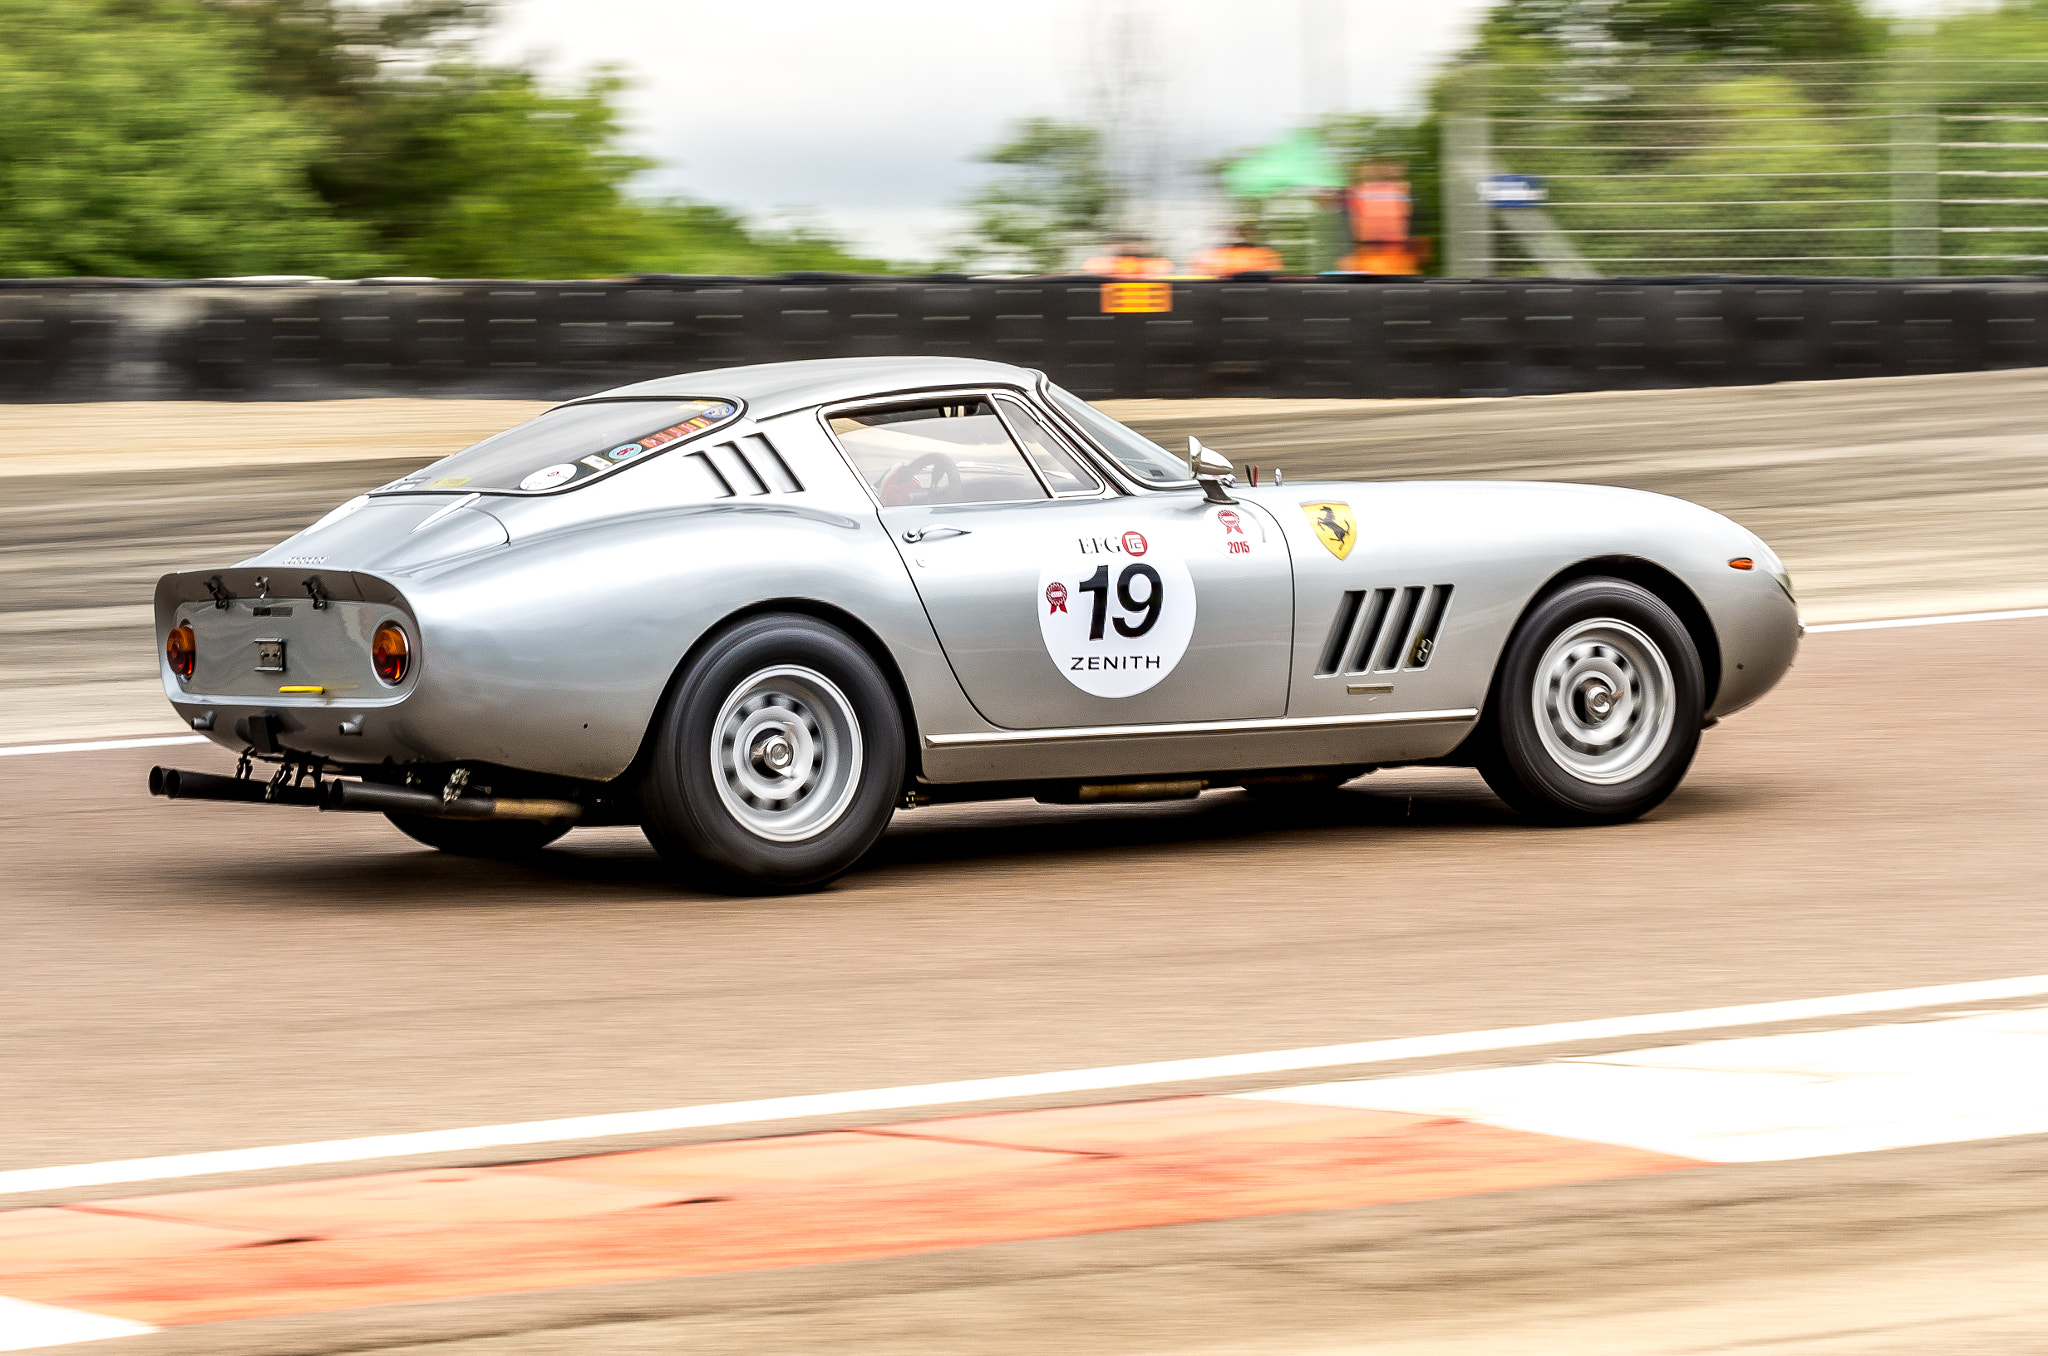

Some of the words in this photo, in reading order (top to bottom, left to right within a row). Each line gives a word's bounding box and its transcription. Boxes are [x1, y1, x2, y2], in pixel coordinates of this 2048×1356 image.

[1078, 536, 1121, 555] EFG
[1227, 541, 1250, 554] 2015
[1079, 563, 1164, 641] 19
[1071, 655, 1161, 671] ZENITH
